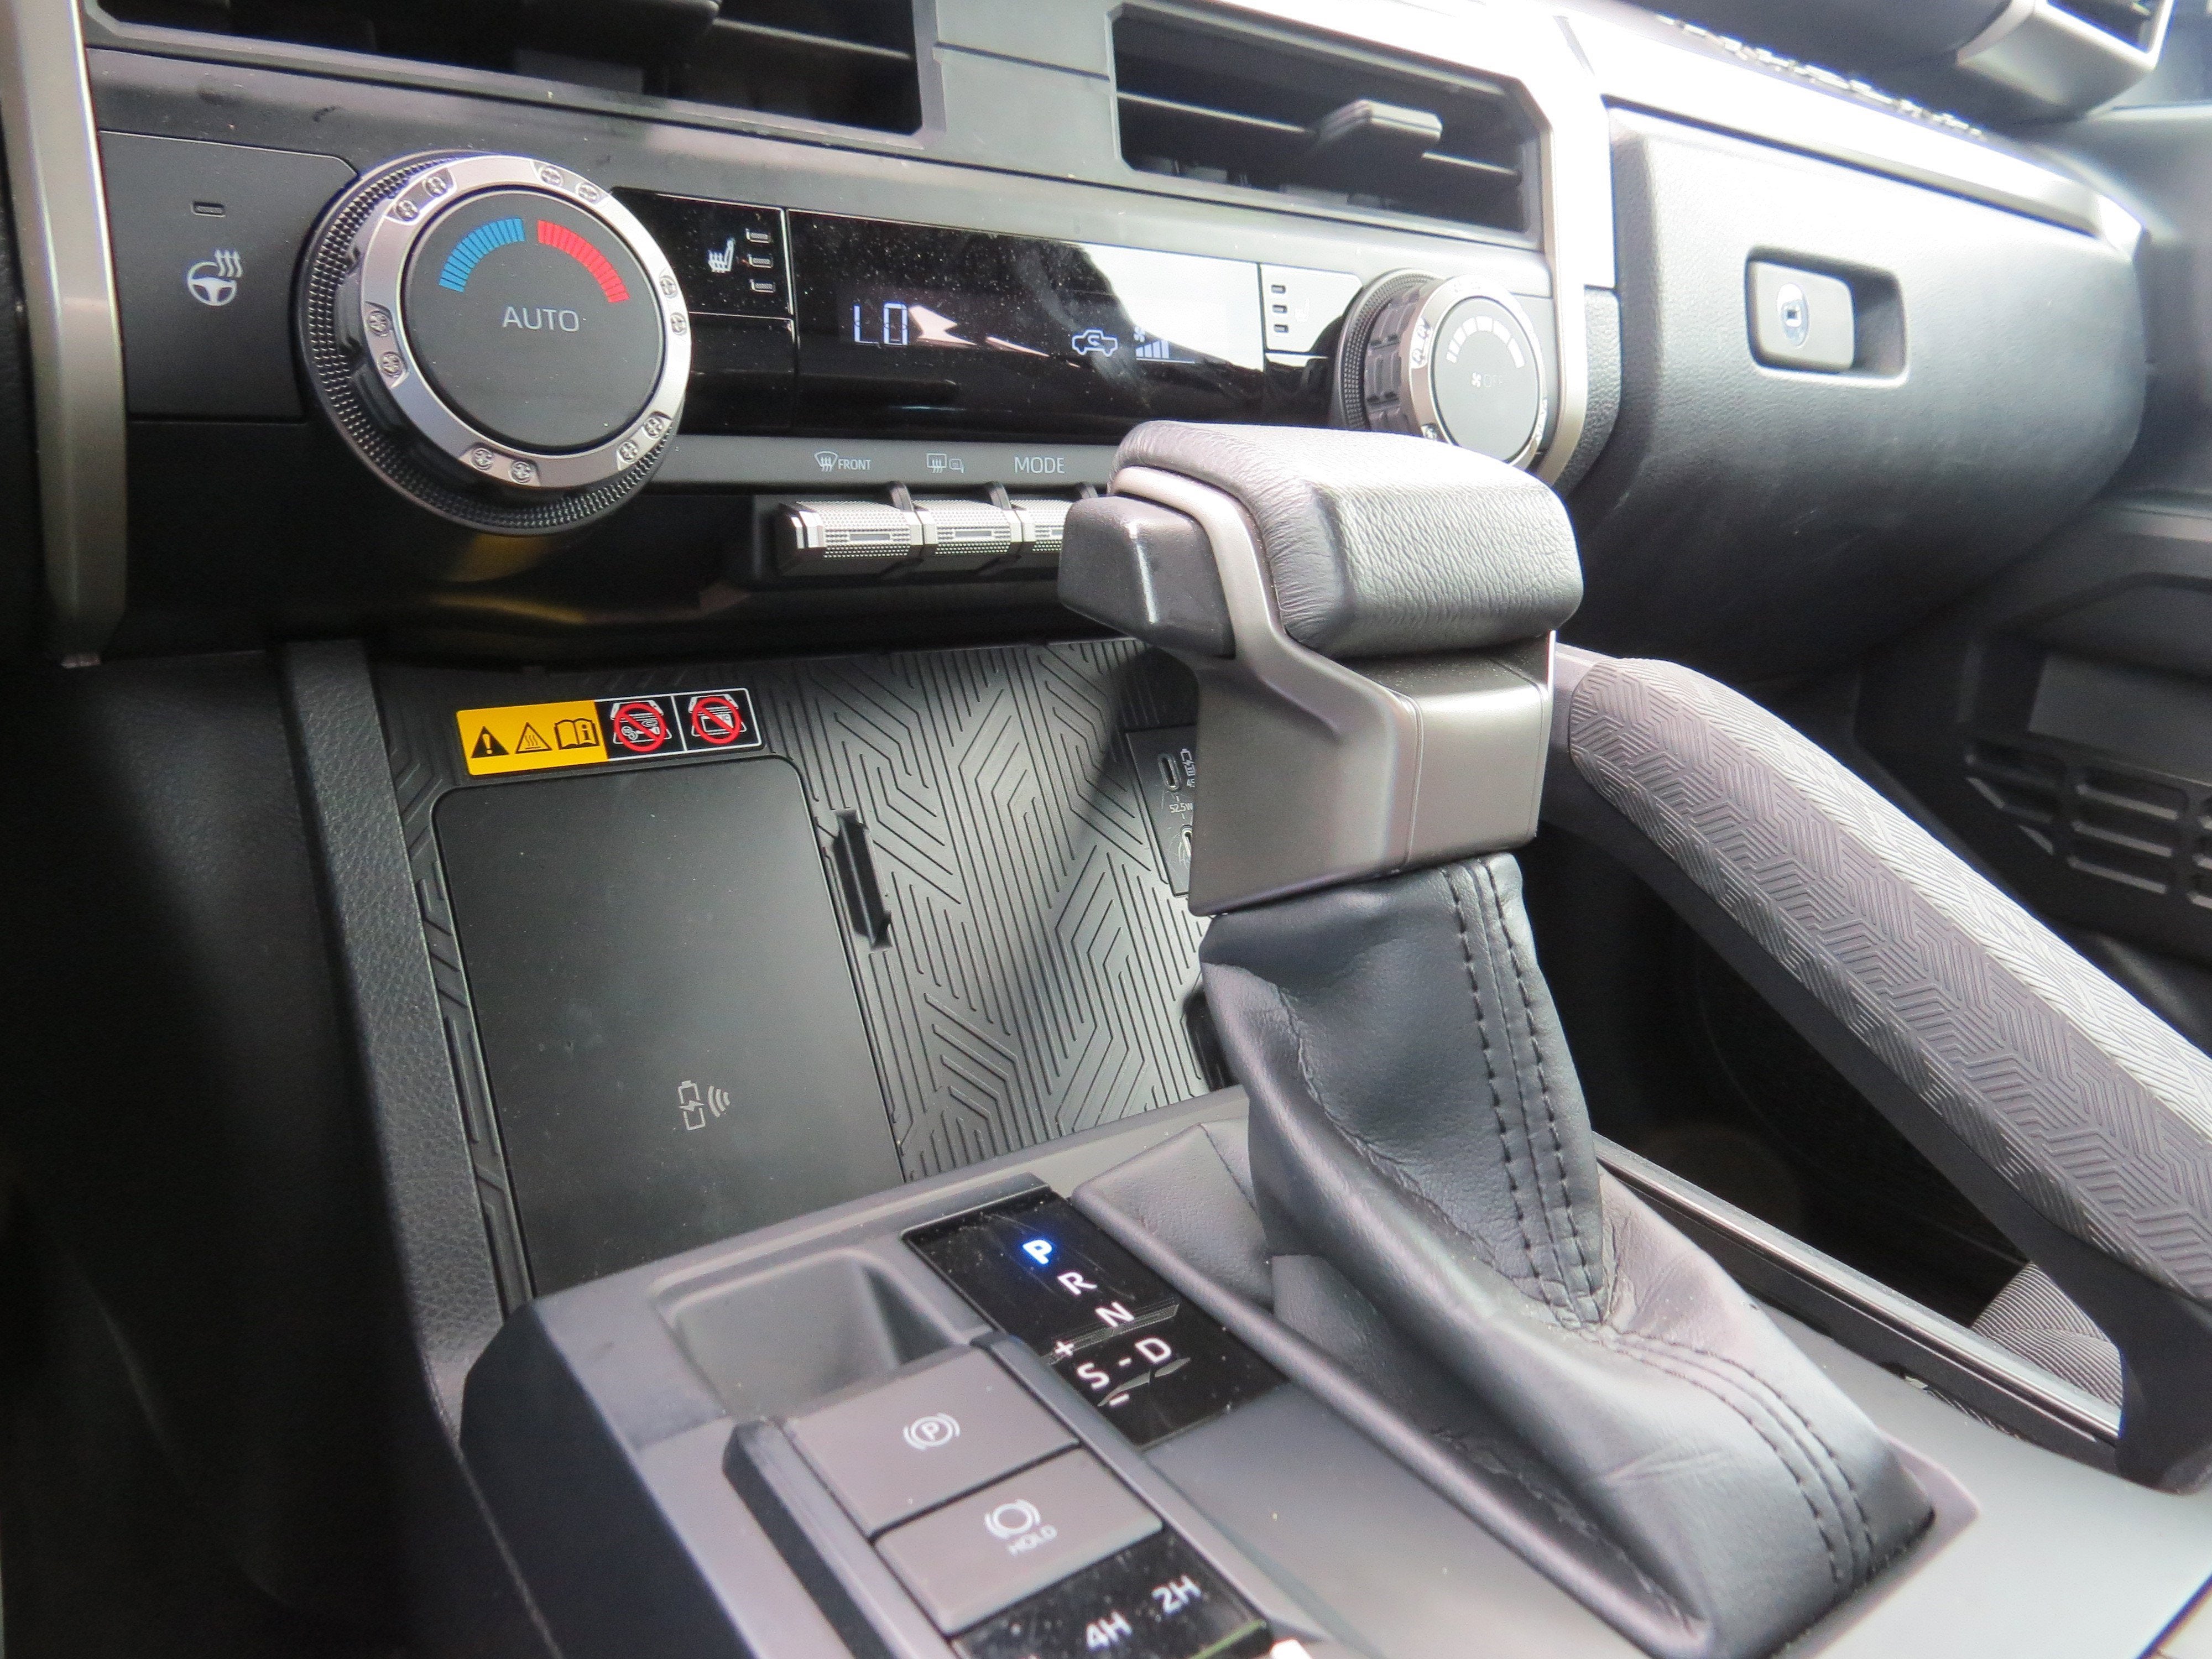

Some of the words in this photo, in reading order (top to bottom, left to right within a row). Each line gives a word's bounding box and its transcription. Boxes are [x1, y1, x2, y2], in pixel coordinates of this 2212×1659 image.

[502, 305, 579, 332] AUTO
[853, 302, 908, 346] LO
[838, 458, 871, 471] FRONT
[1014, 456, 1065, 474] MODE
[1022, 1239, 1052, 1264] P
[1057, 1272, 1097, 1295] R
[1095, 1302, 1134, 1327] N
[1077, 1363, 1109, 1389] S
[1135, 1338, 1172, 1363] D
[1008, 1525, 1057, 1556] HOLD
[1085, 1612, 1132, 1651] 4H
[1152, 1574, 1201, 1616] 2H
